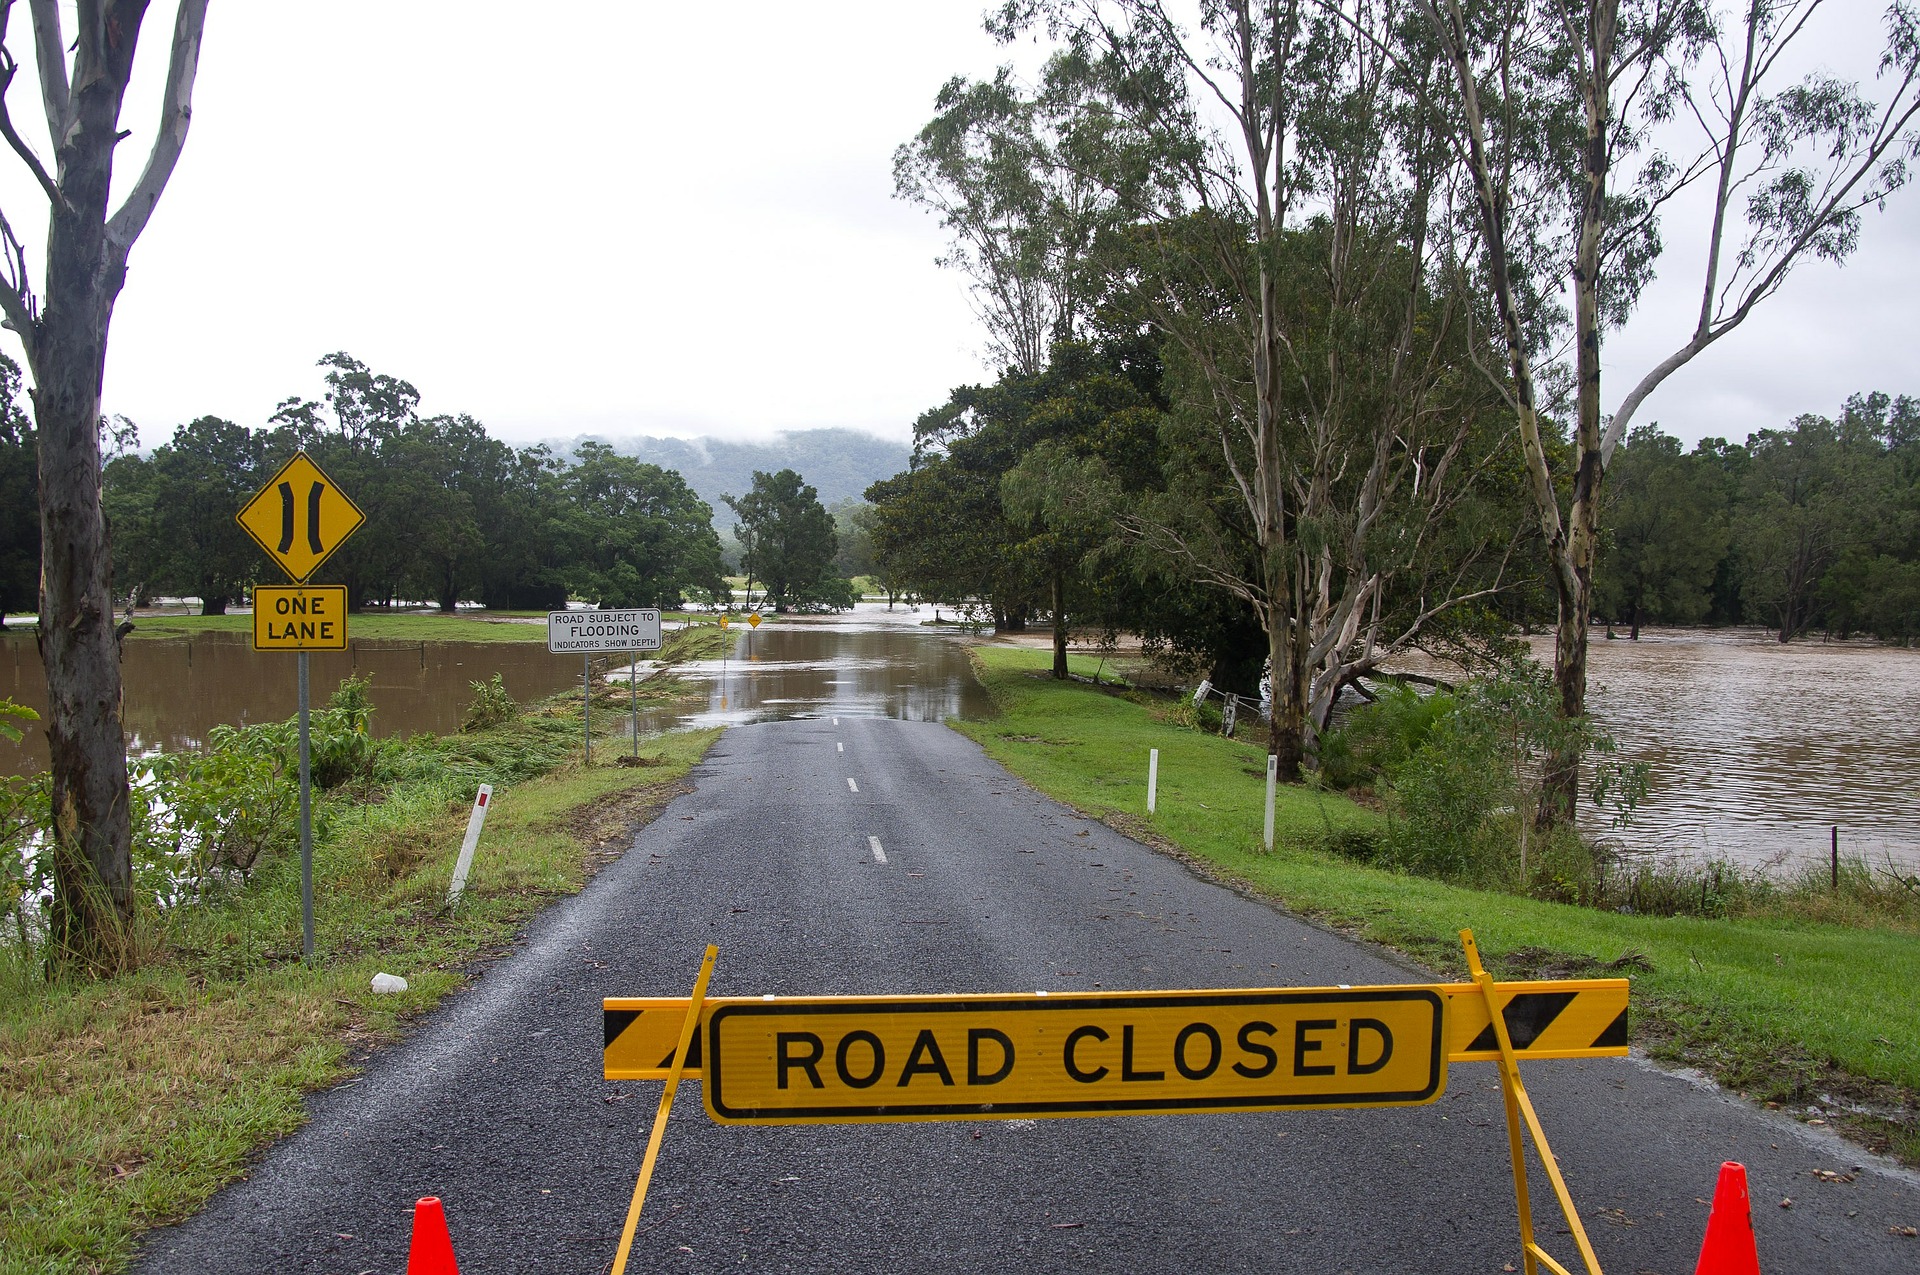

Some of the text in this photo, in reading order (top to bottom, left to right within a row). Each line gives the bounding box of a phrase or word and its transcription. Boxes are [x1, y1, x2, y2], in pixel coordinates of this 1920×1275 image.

[275, 597, 325, 615] ONE
[555, 612, 654, 624] ROAD SUBJECT TO
[268, 621, 334, 640] LANE
[571, 625, 640, 637] FLOODING
[554, 638, 656, 649] INDICATORS SHOW DEPTH
[776, 1017, 1394, 1090] ROAD CLOSED
